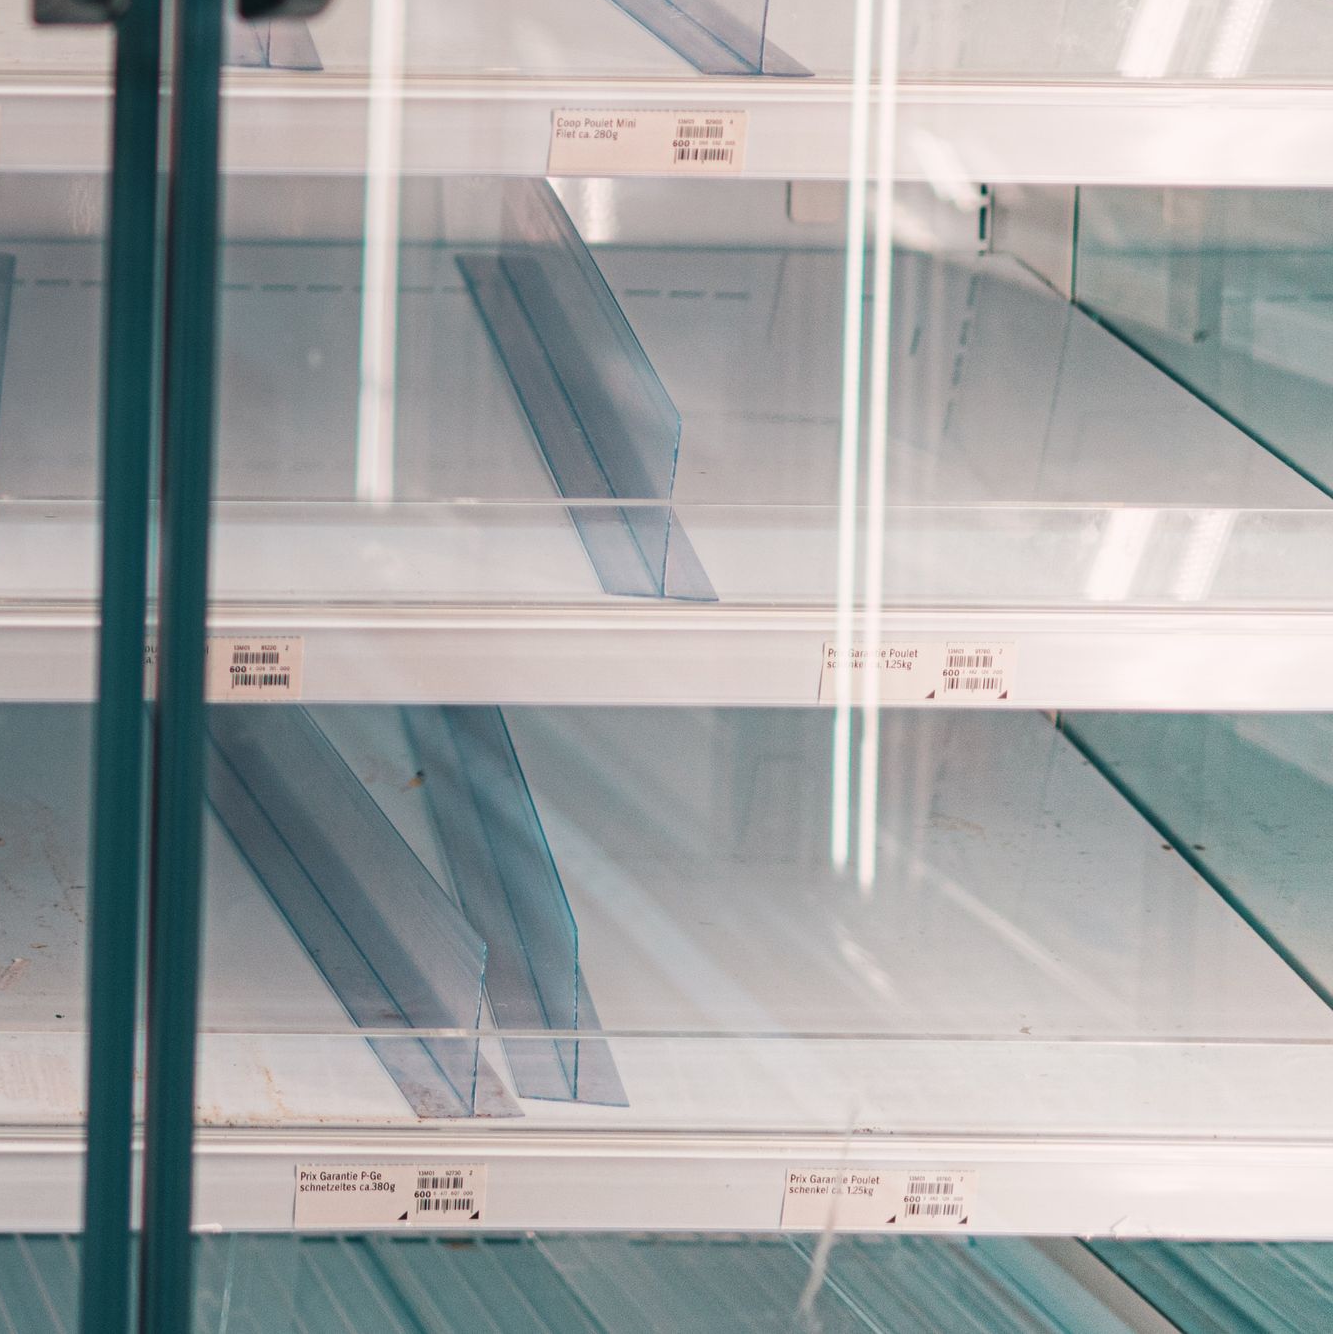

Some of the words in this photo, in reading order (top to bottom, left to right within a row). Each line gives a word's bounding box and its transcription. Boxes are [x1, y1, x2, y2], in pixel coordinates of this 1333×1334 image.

[557, 118, 581, 128] Coop
[585, 119, 613, 128] Poulet
[617, 119, 636, 128] Mini
[556, 130, 576, 138] Filet
[594, 130, 618, 140] 280g
[889, 649, 918, 658] Poulet
[301, 1171, 316, 1181] Prix
[320, 1171, 358, 1181] Garantie
[361, 1171, 382, 1181] P-Ge
[790, 1174, 806, 1184] Prix
[851, 1175, 880, 1185] Poulet
[300, 1183, 356, 1192] schnetzeltes
[789, 1186, 829, 1194] schenkel
[847, 1186, 873, 1196] 1.25kg
